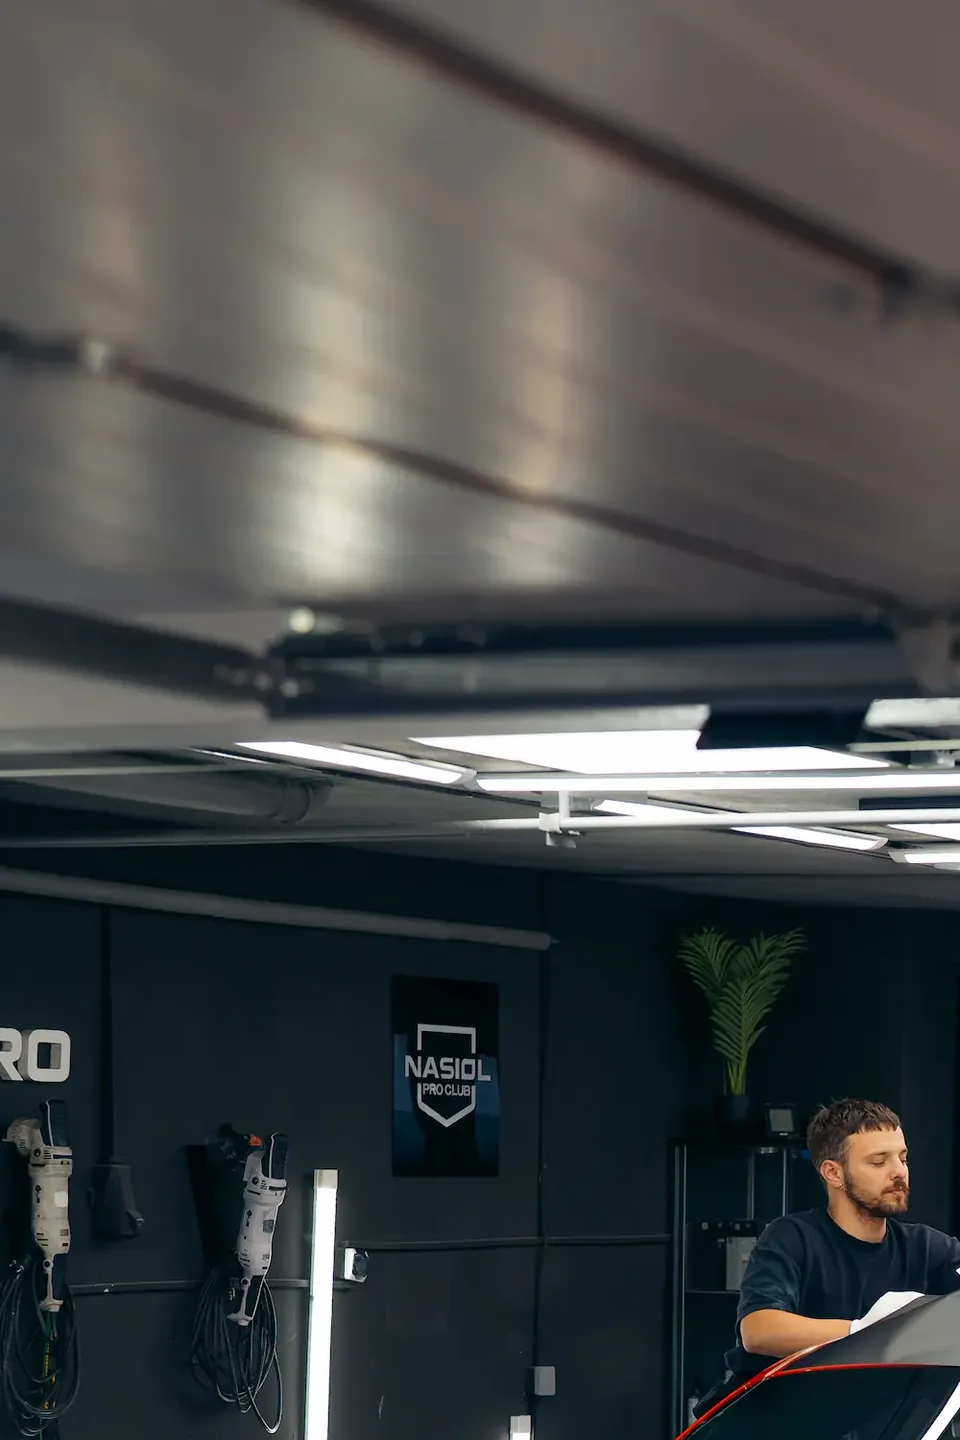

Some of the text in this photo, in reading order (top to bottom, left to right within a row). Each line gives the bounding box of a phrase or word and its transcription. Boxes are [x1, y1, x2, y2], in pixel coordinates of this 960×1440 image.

[404, 1055, 491, 1081] NASIOL
[422, 1083, 471, 1096] PRO CLUB
